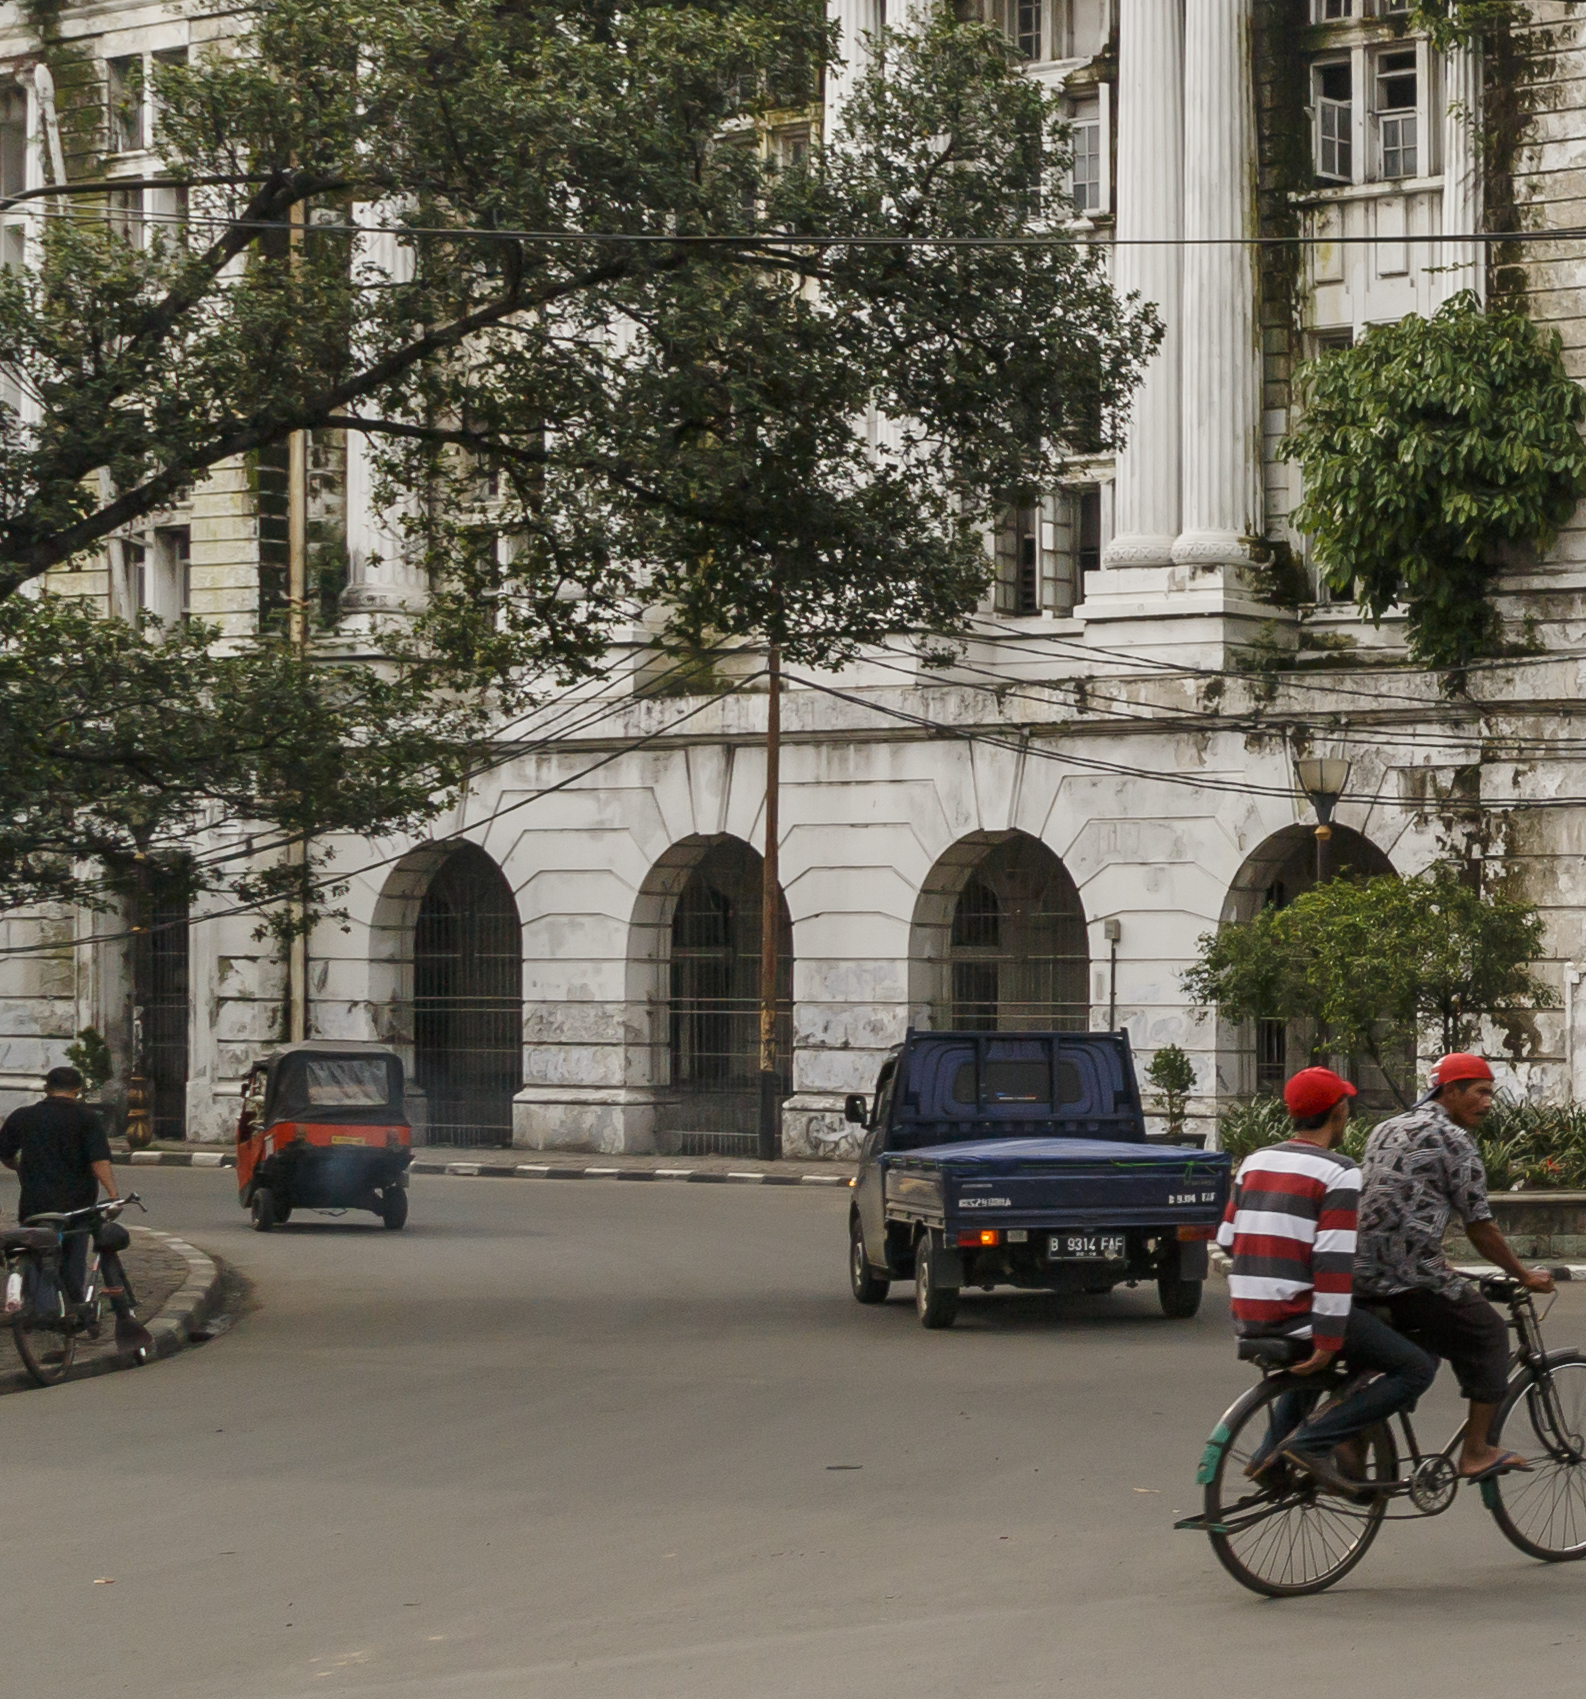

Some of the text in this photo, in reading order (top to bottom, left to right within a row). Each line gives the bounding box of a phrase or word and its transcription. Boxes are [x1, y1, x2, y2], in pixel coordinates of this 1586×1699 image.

[1051, 1237, 1123, 1251] B 9314 FAF
